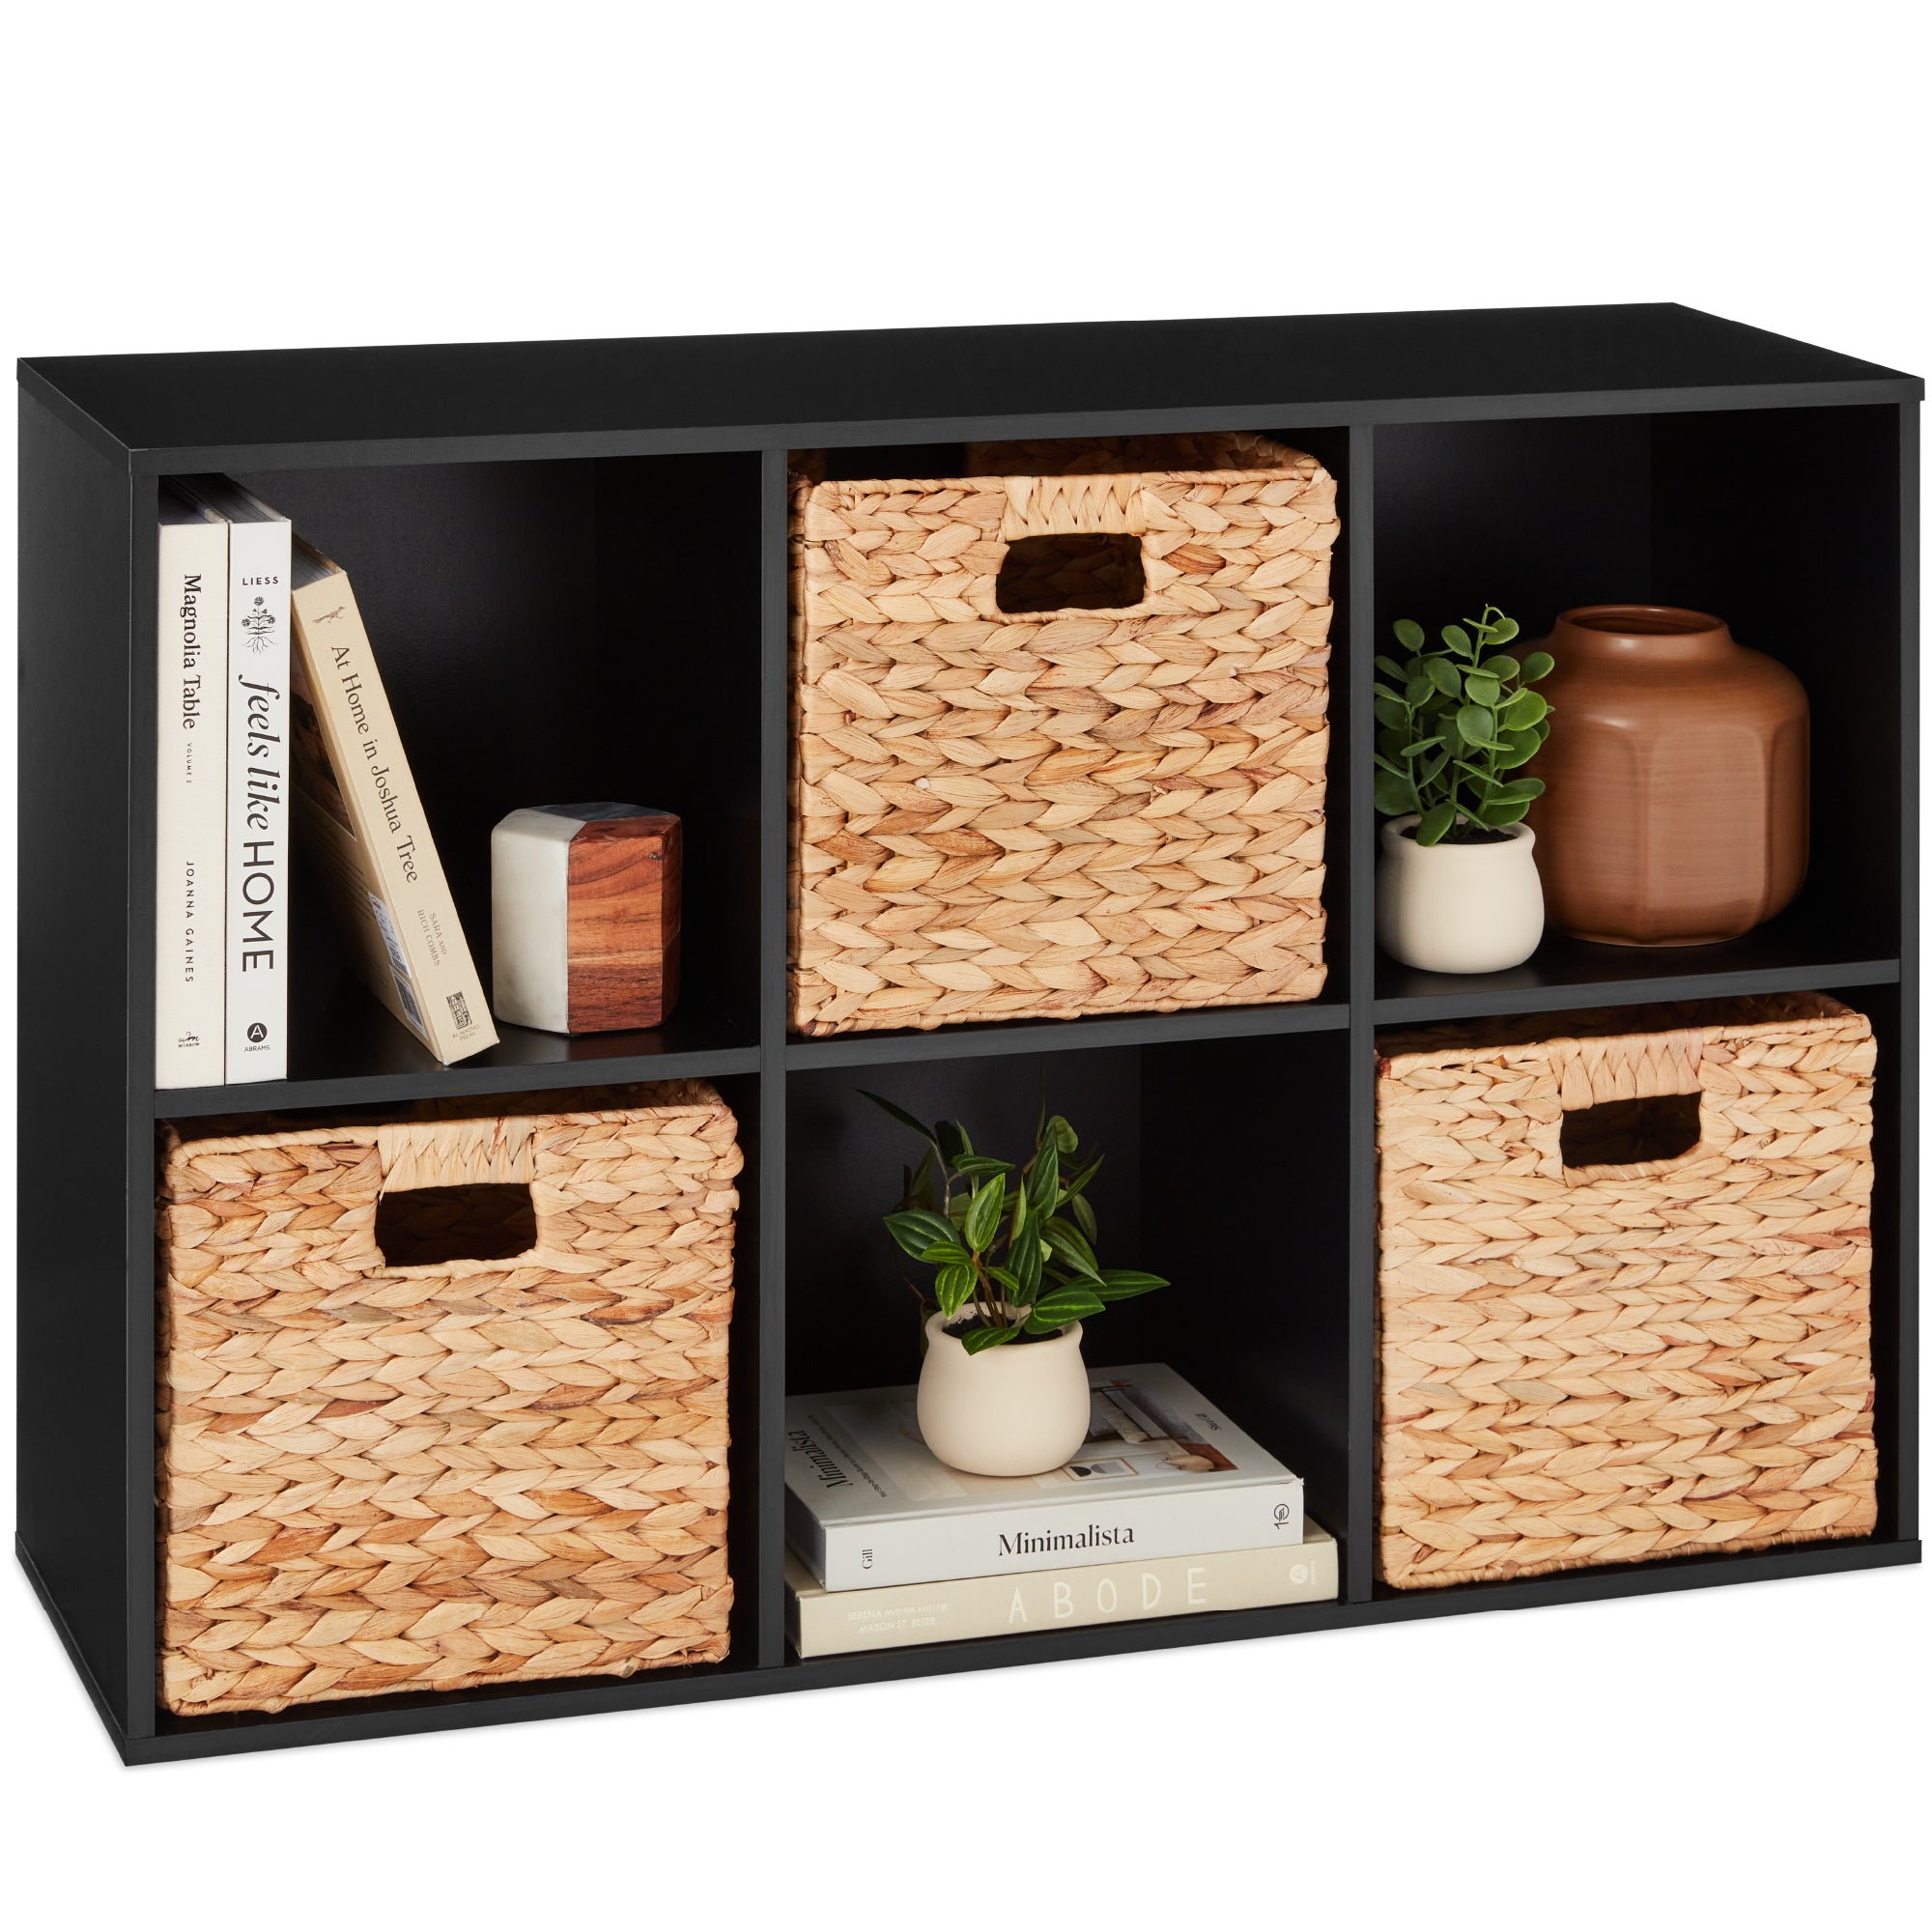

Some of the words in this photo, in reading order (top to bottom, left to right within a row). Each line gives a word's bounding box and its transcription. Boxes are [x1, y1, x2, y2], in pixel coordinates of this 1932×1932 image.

[242, 577, 279, 586] LIESS
[180, 574, 202, 669] Magnolia
[183, 674, 201, 729] Table
[239, 673, 280, 758] feels
[330, 645, 352, 670] At
[341, 672, 369, 734] Home
[362, 739, 378, 759] in
[371, 766, 402, 834] Joshua
[396, 835, 418, 884] Tree
[246, 766, 280, 831] like
[185, 861, 194, 919] JOANNA
[242, 840, 274, 973] HOME
[417, 909, 430, 933] RICH
[426, 934, 440, 967] COMBS
[430, 912, 442, 939] SARA
[185, 928, 194, 982] GAINES
[788, 1430, 854, 1489] Minimalista
[862, 1548, 873, 1570] Gill
[998, 1523, 1135, 1556] Minimalista
